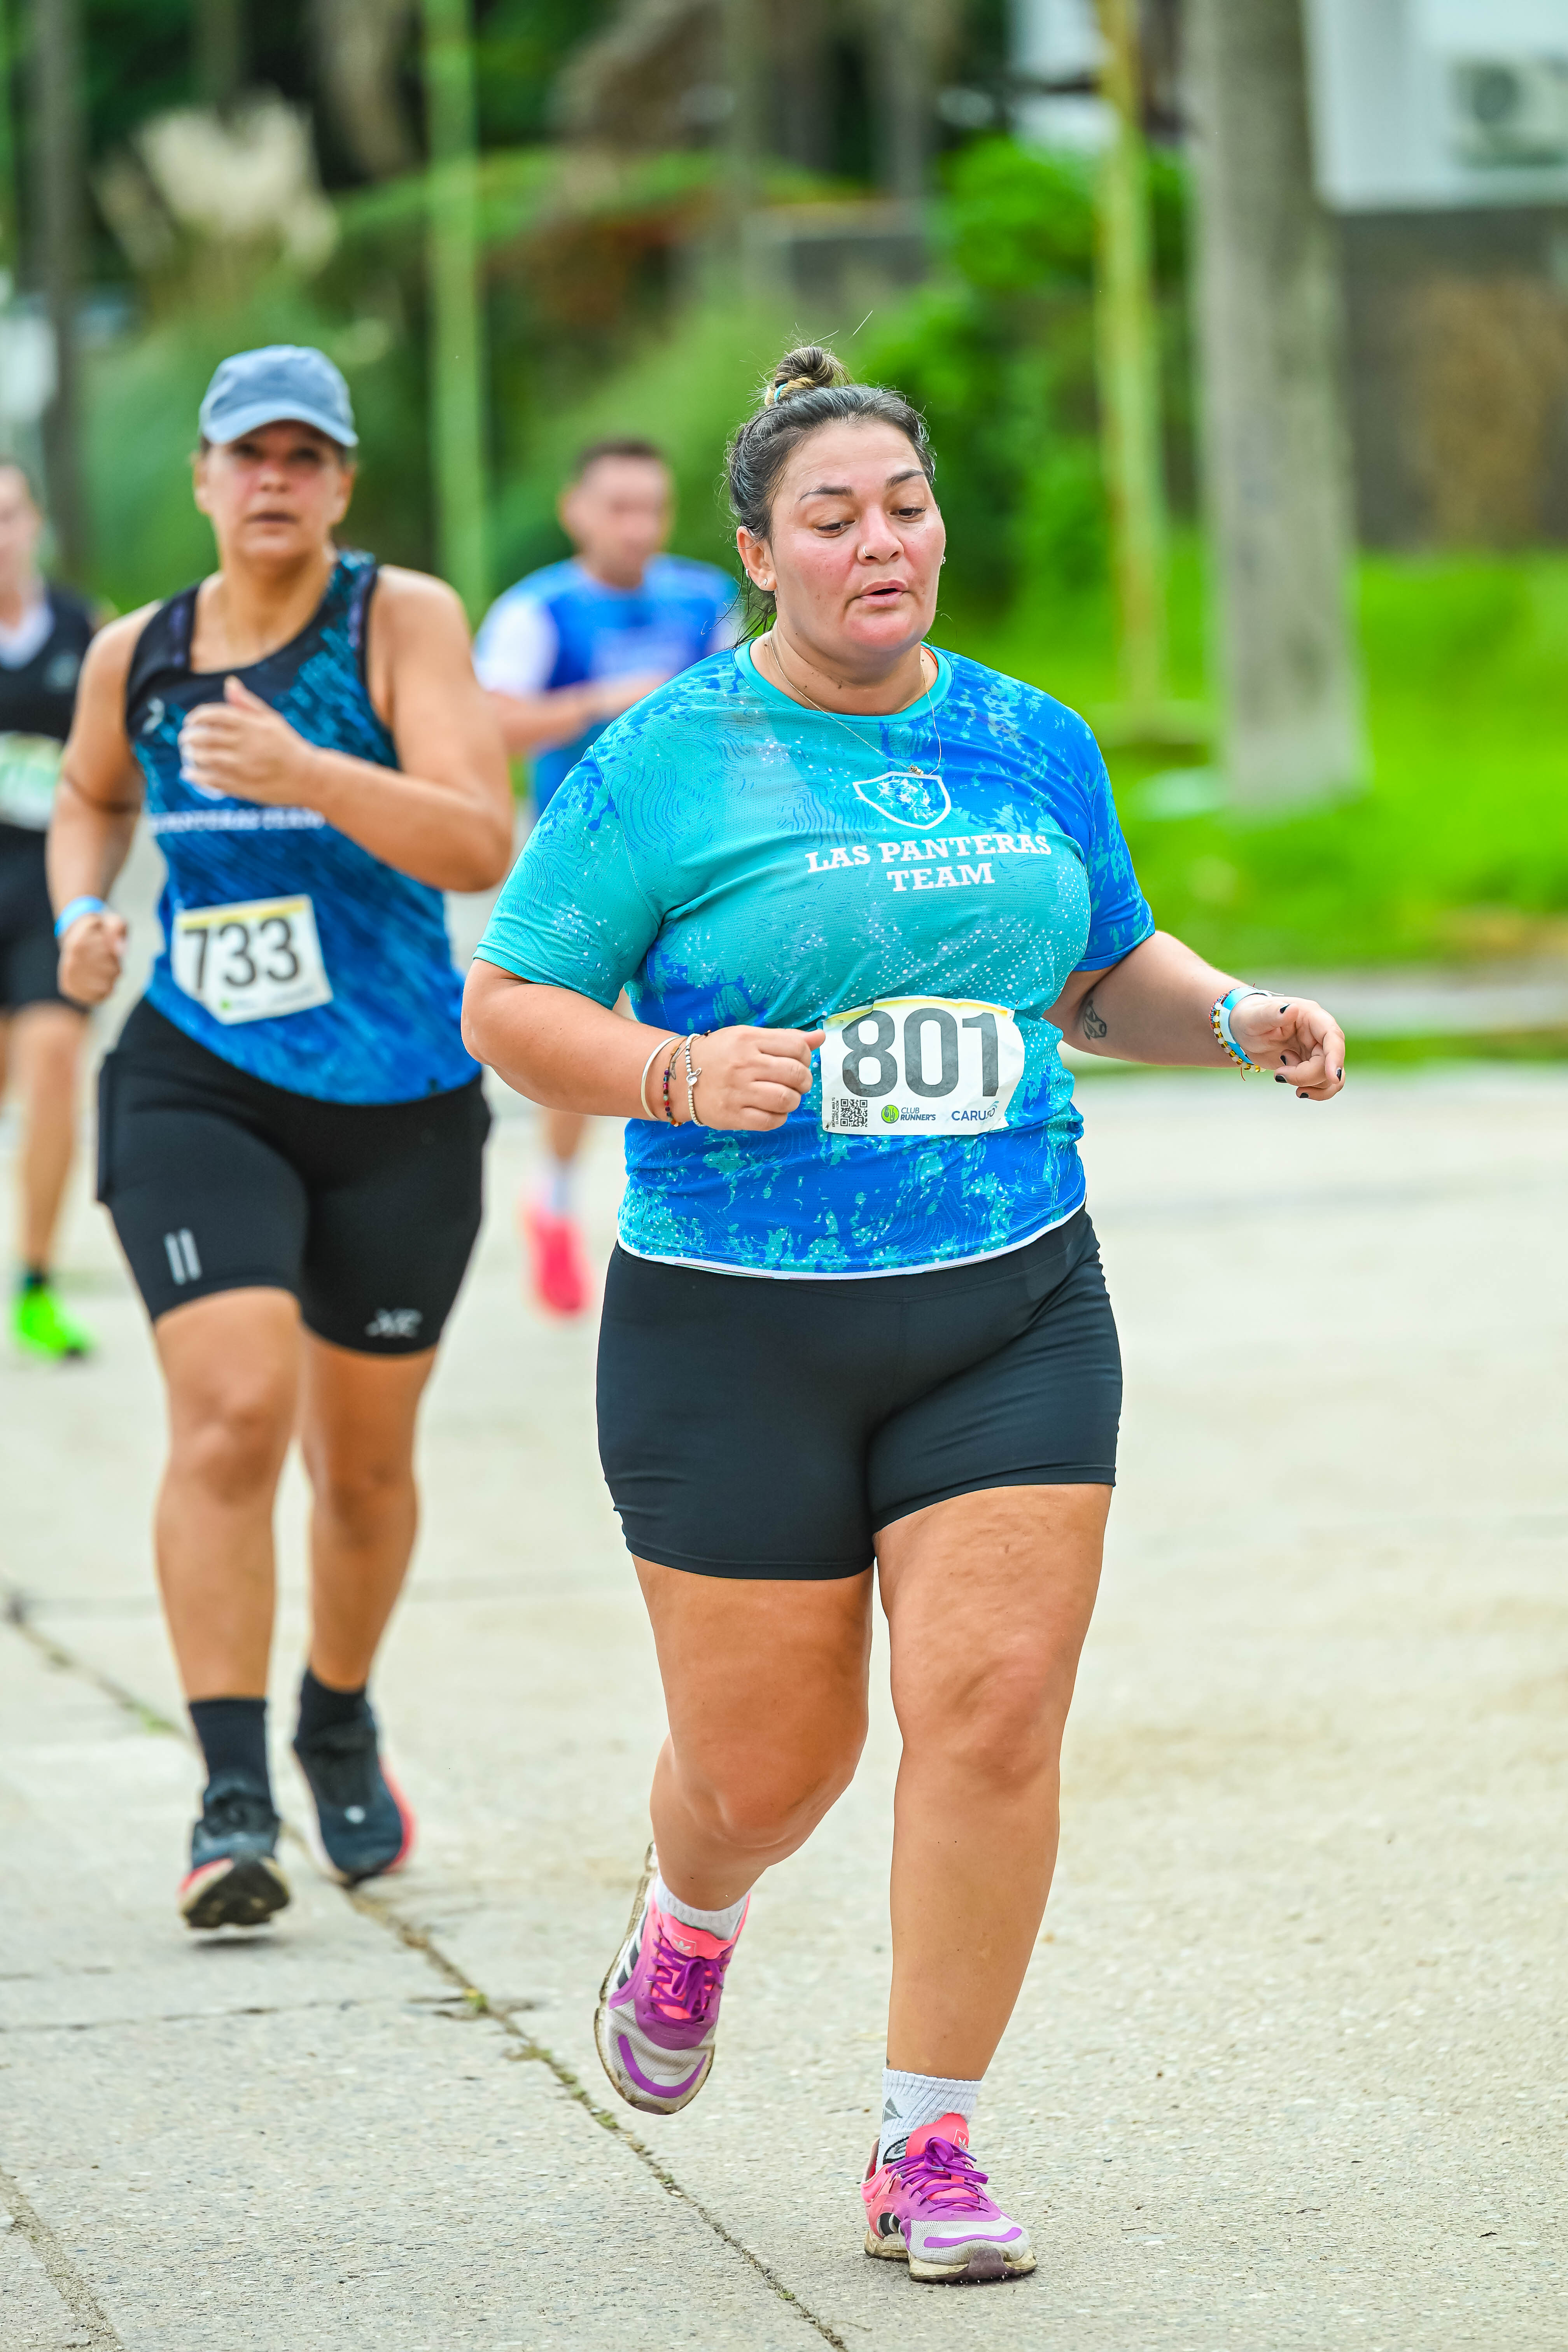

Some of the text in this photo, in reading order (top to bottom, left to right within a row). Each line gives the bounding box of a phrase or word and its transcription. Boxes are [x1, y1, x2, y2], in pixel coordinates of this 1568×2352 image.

[805, 833, 1052, 873] LAS PANTERAS
[887, 862, 995, 892] TEAM
[183, 917, 300, 990] 733
[842, 1008, 999, 1097] 801
